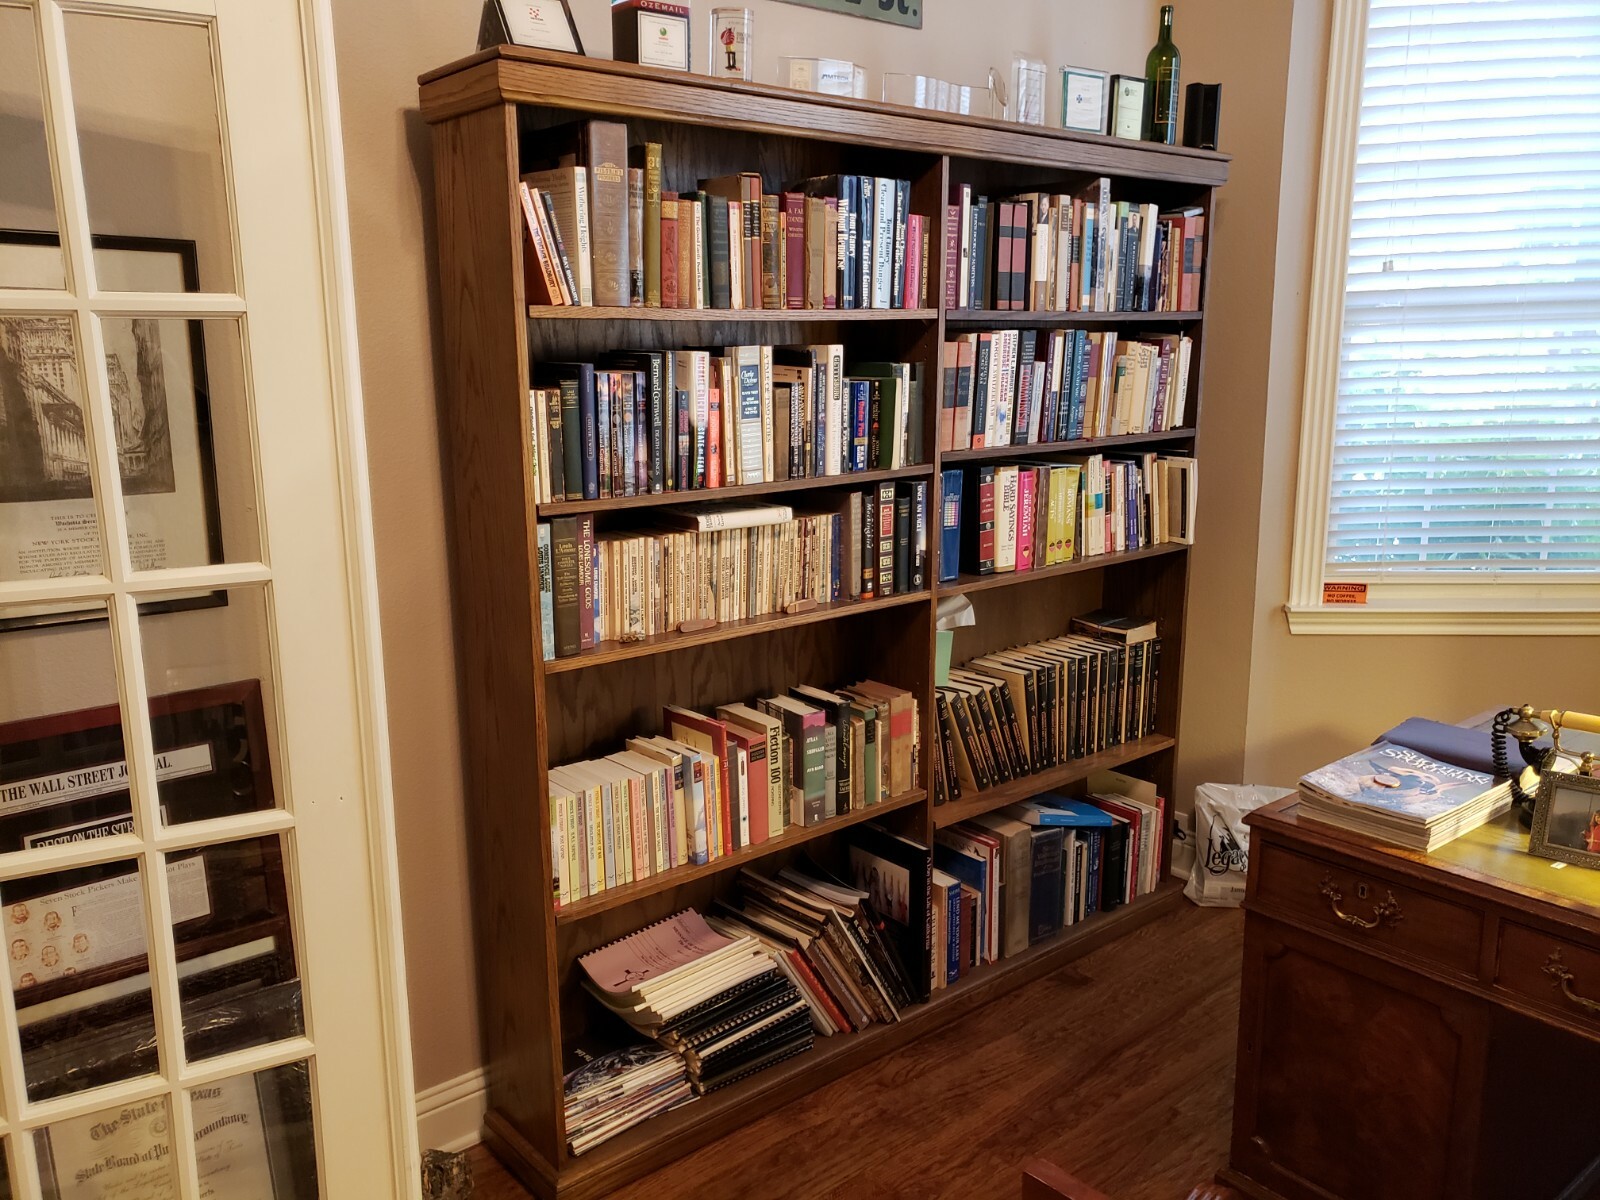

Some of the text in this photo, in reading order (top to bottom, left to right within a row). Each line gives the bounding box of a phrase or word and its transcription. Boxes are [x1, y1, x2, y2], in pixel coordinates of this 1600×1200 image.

[640, 1, 685, 13] OZEMAIL
[578, 187, 586, 224] Wuthering
[837, 199, 848, 270] Without Remorse
[846, 231, 856, 257] Clancy
[543, 261, 555, 288] BRADBURY
[566, 270, 579, 301] BRADBURY
[652, 359, 661, 390] Bernard
[765, 383, 770, 393] OF
[652, 391, 661, 426] Cornwell
[1018, 369, 1031, 428] COMMUNISM
[916, 504, 921, 512] AN
[864, 503, 873, 549] Mockingbird
[770, 726, 781, 784] Fiction 100
[1379, 748, 1488, 785] SPORTSMAN
[1, 785, 26, 803] THE
[28, 779, 65, 797] WALL
[67, 767, 115, 788] STREET
[84, 825, 110, 840] THE
[177, 861, 196, 872] Plays
[39, 875, 138, 906] Seven Stock Pickers Make
[858, 927, 869, 944] GRECO
[955, 916, 959, 925] ME
[89, 1100, 159, 1141] The State
[75, 1162, 105, 1184] State
[105, 1153, 139, 1170] Board
[142, 1150, 153, 1162] of
